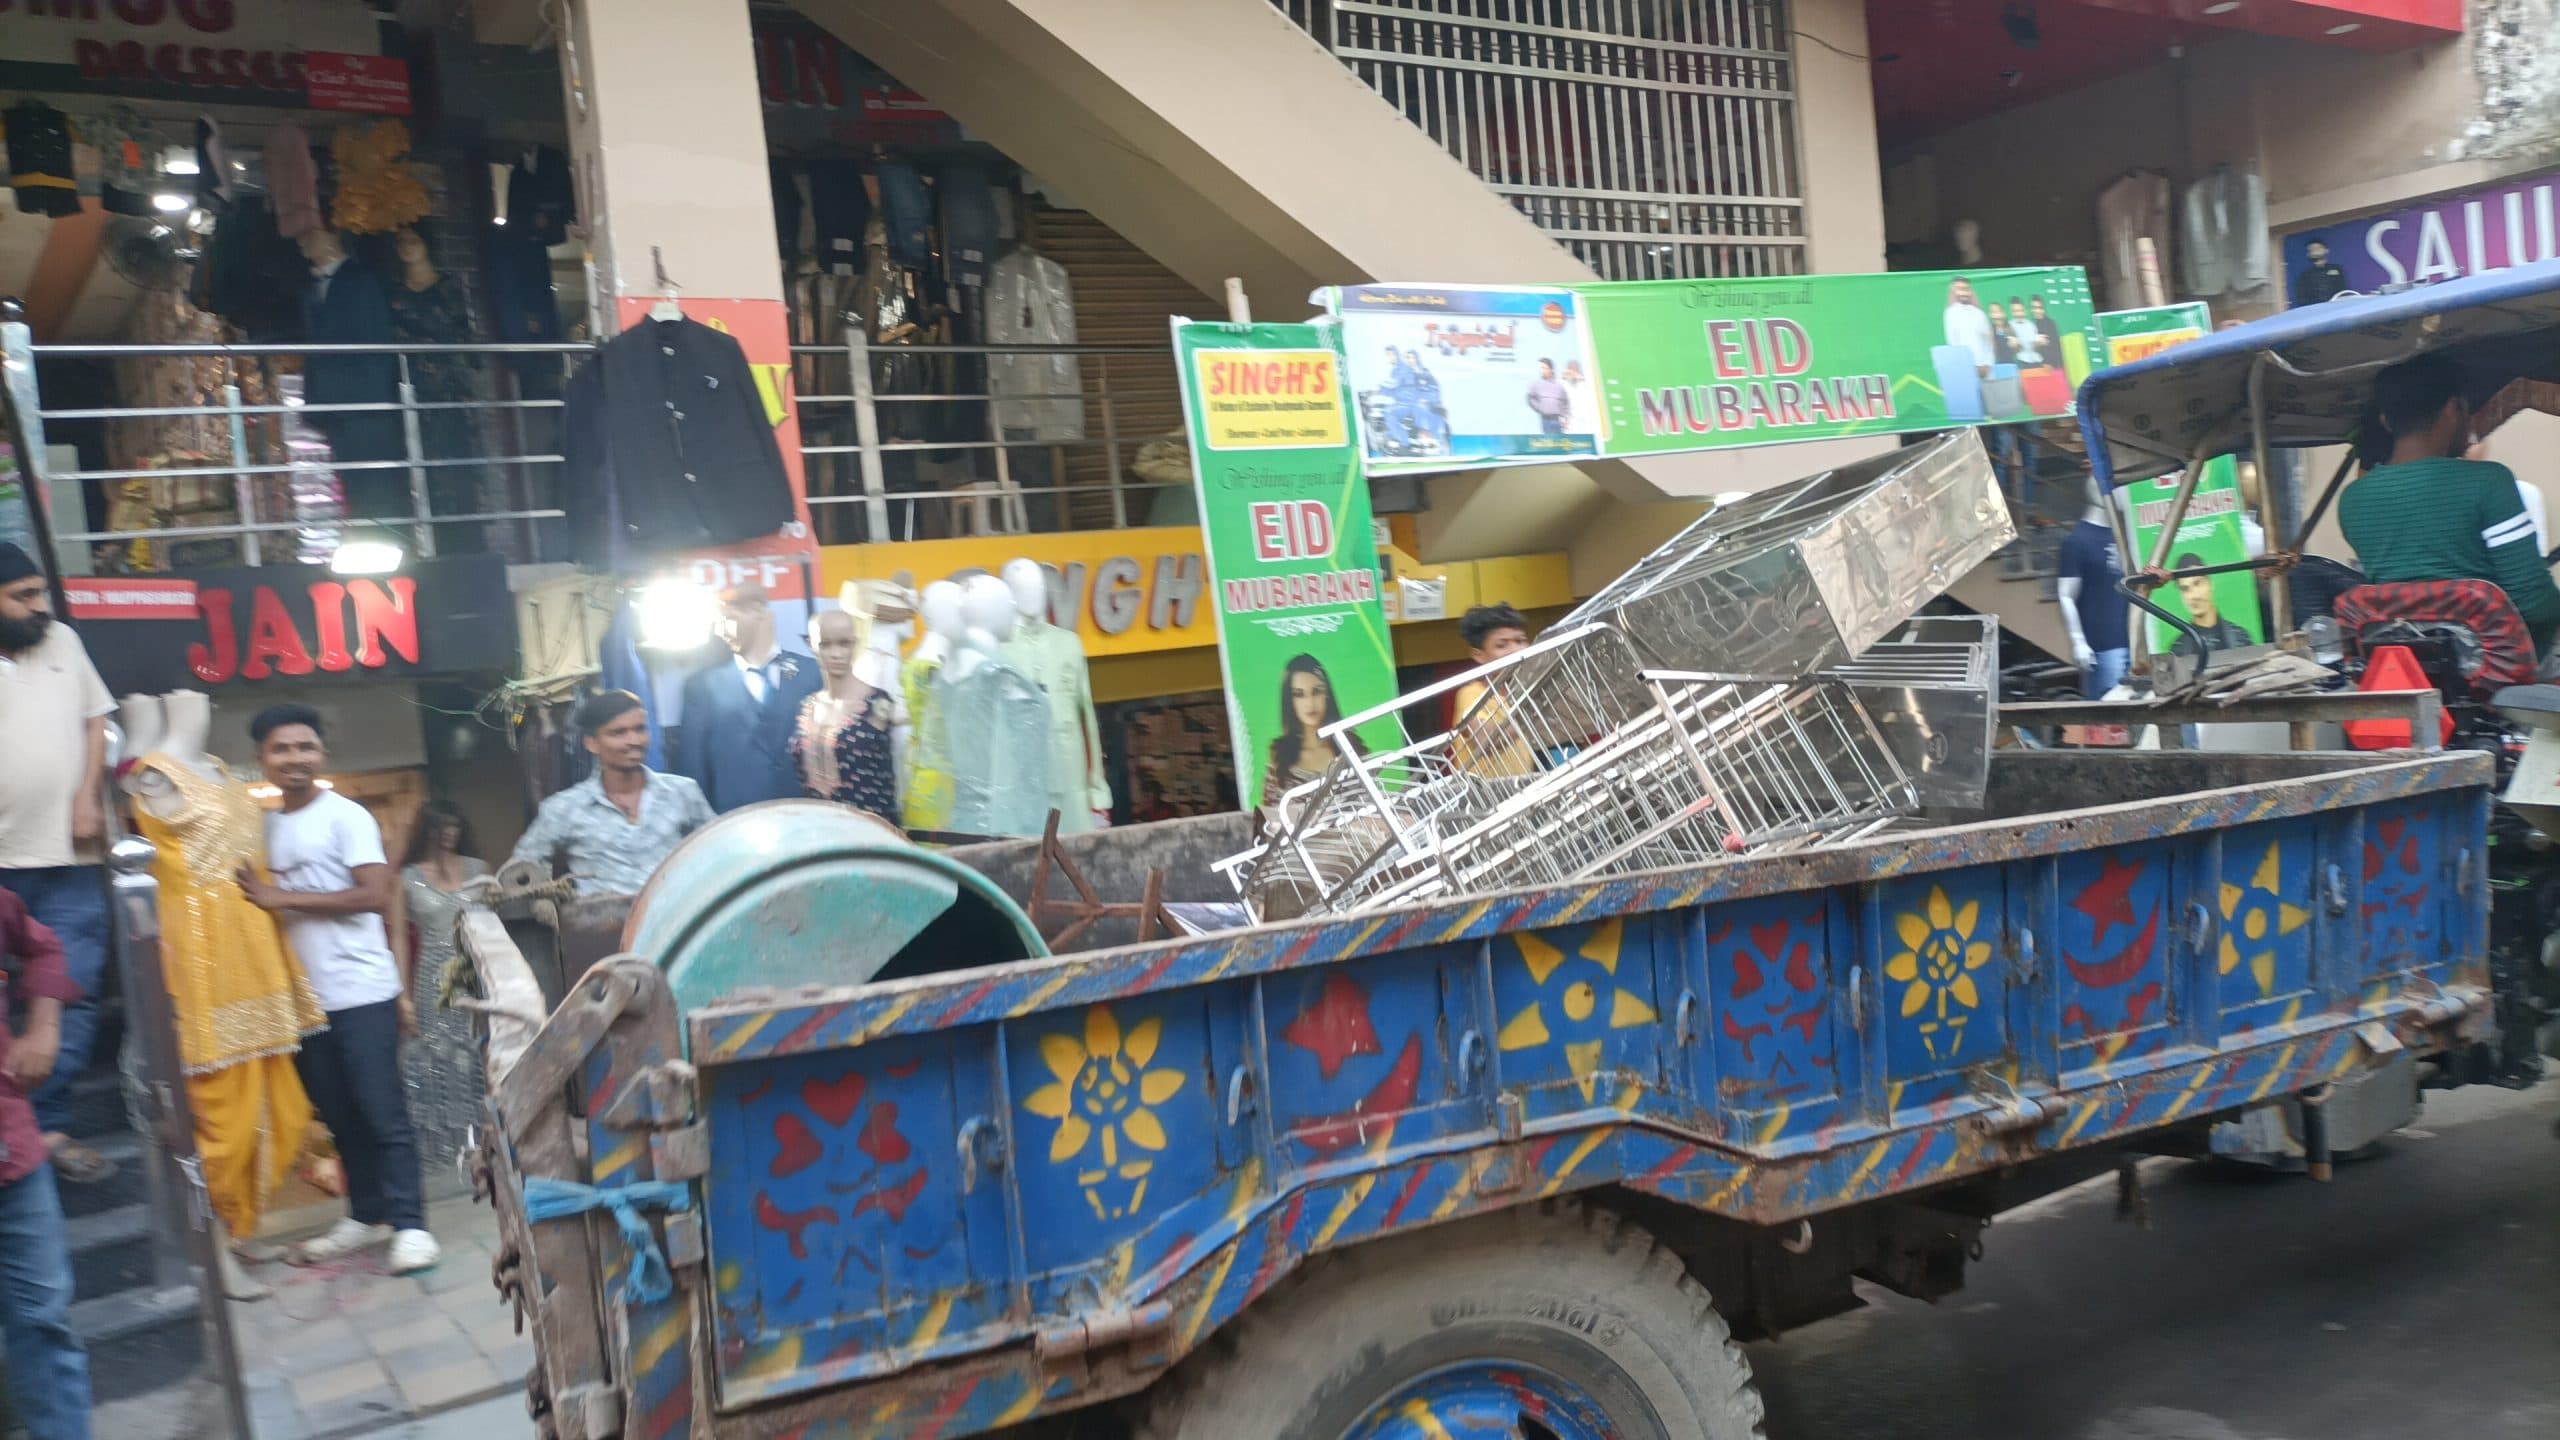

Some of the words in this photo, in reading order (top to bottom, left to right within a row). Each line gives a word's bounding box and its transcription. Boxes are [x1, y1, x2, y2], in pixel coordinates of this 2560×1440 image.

[1210, 360, 1329, 396] SINGH'S
[1703, 317, 1814, 380] EID
[1636, 374, 1897, 437] MUBARAKH
[1248, 500, 1336, 562] EID
[688, 555, 790, 592] OFF
[1222, 568, 1378, 614] MUBARAKH
[187, 577, 419, 684] JAIN
